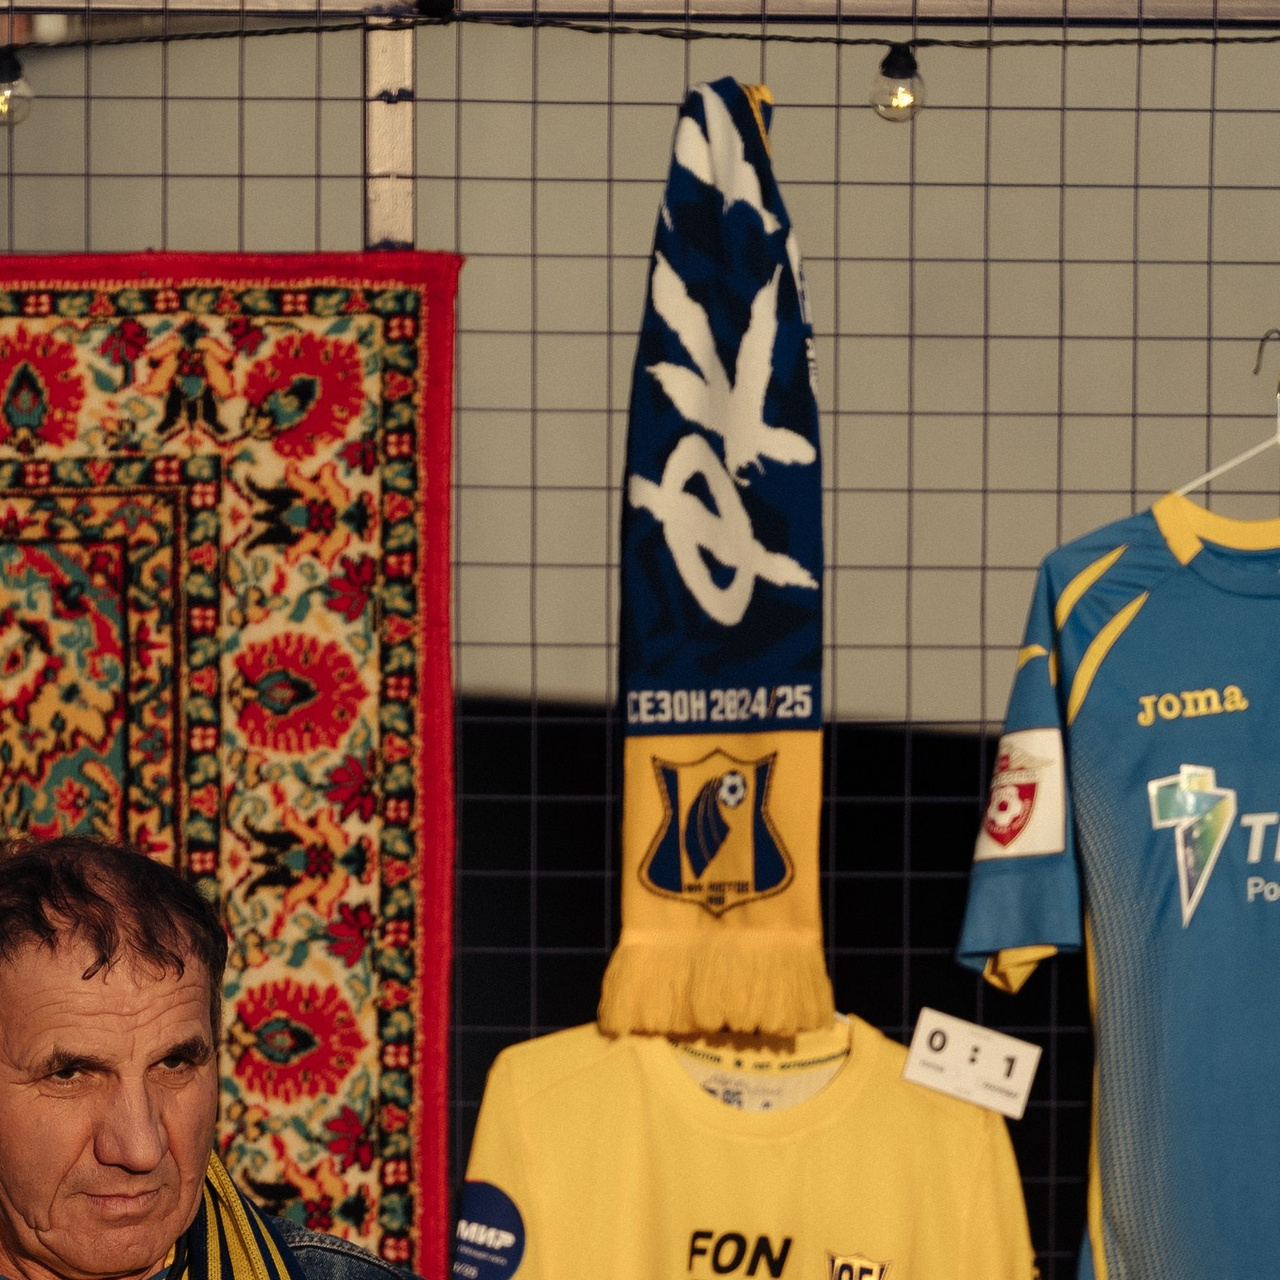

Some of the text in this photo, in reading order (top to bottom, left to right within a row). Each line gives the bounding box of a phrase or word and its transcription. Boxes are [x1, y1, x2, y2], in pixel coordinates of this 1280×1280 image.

[627, 685, 812, 724] СЕЗОН 2024/25
[929, 1030, 947, 1052] 0
[1004, 1057, 1016, 1078] 1
[688, 1231, 792, 1279] FON
